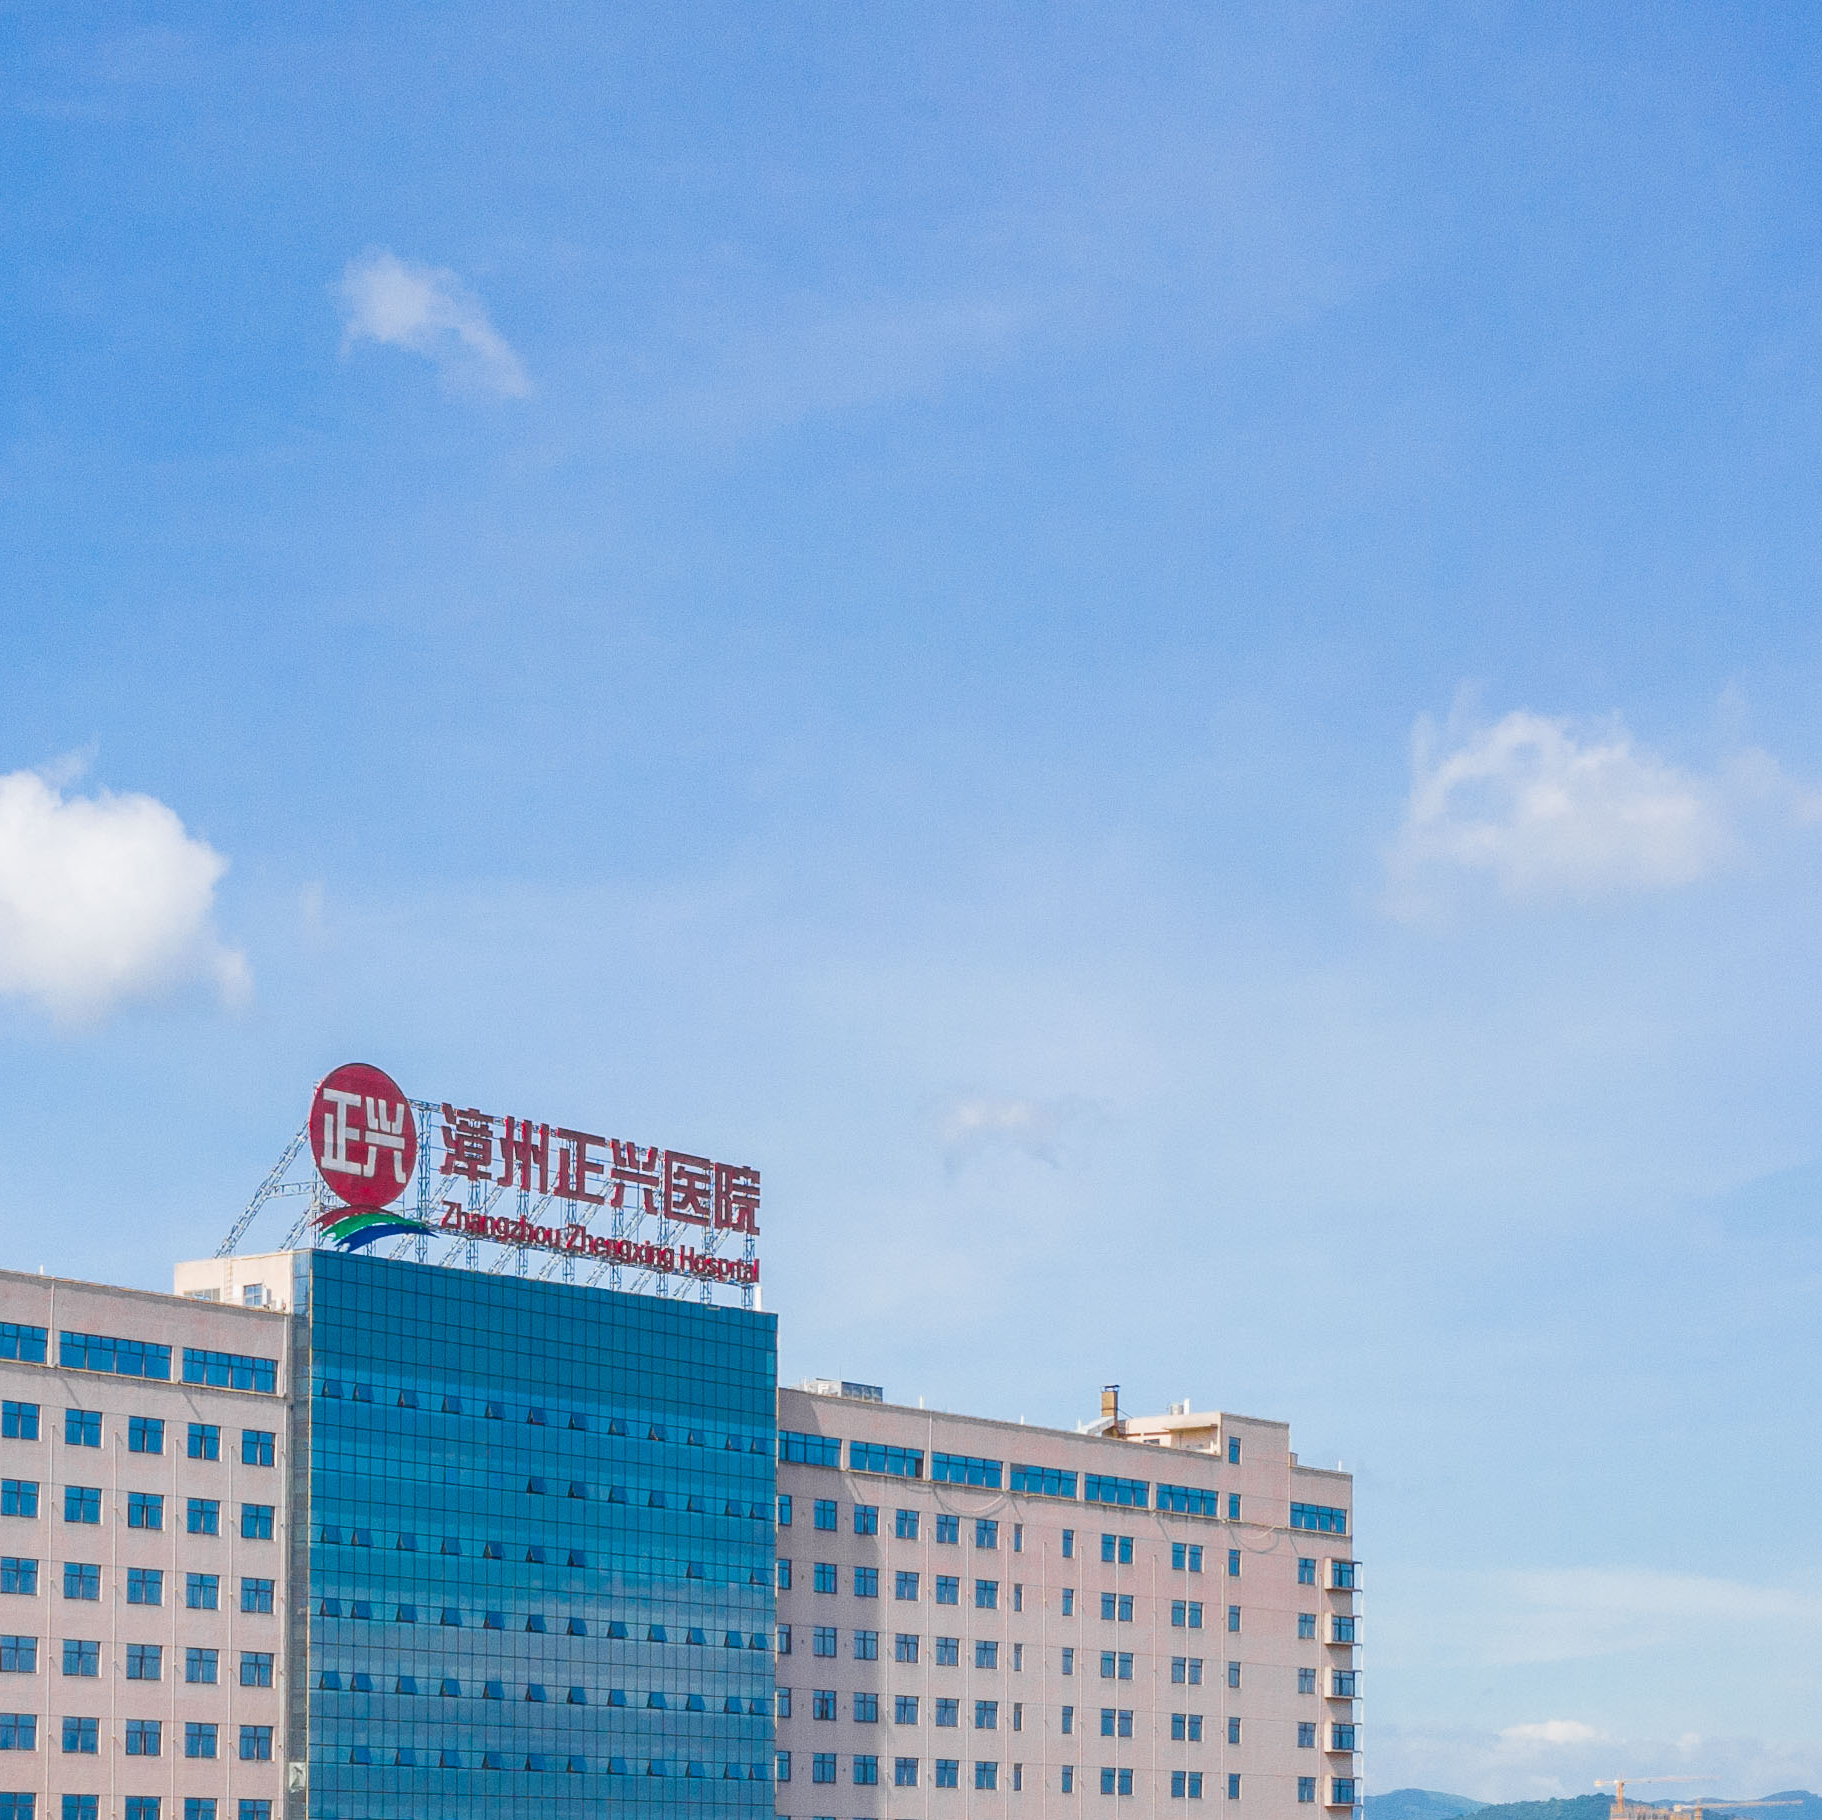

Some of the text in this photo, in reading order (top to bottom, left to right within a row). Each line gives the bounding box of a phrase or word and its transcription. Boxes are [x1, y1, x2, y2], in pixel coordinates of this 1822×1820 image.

[321, 1087, 407, 1184] 正兴
[439, 1101, 761, 1236] 漳州正兴医院
[440, 1199, 760, 1283] Zhangzhou Zhengxing Hospital
